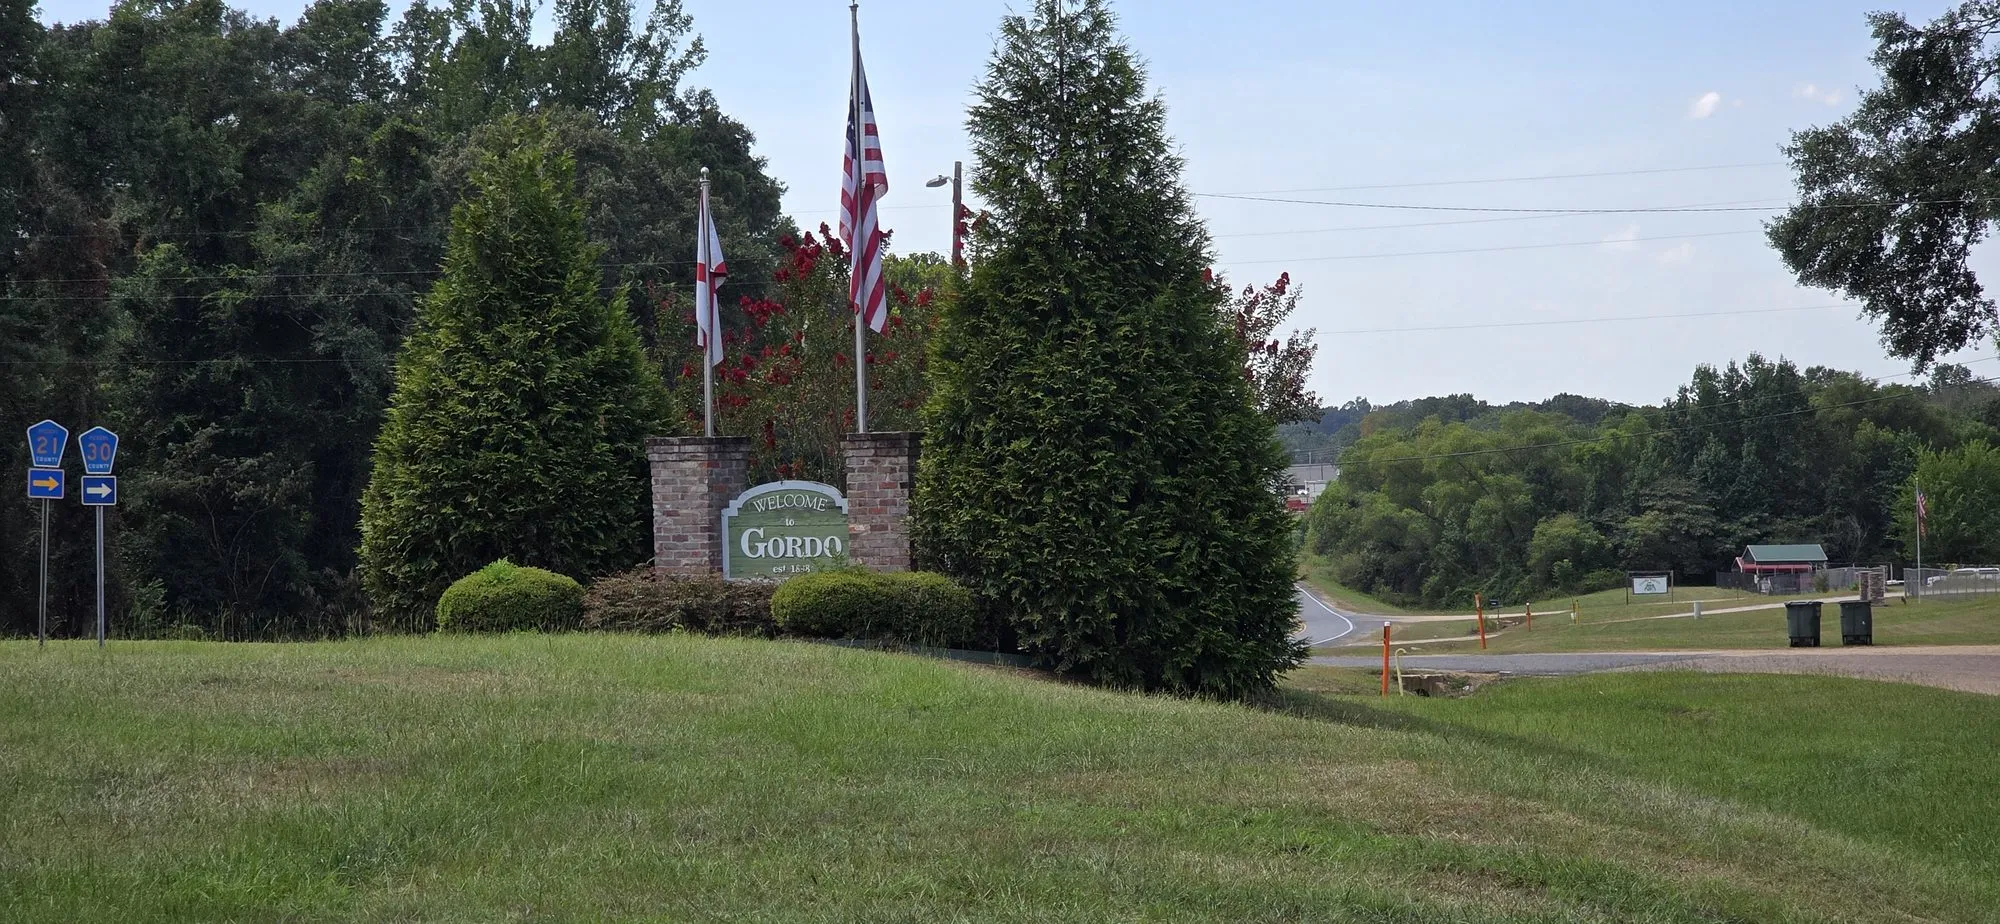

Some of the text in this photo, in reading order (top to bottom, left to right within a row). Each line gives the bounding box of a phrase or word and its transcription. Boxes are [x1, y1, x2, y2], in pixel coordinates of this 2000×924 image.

[36, 436, 58, 454] 21
[87, 442, 111, 461] 30
[753, 493, 828, 513] WELCOME
[785, 518, 795, 526] to
[740, 527, 842, 559] GORDO
